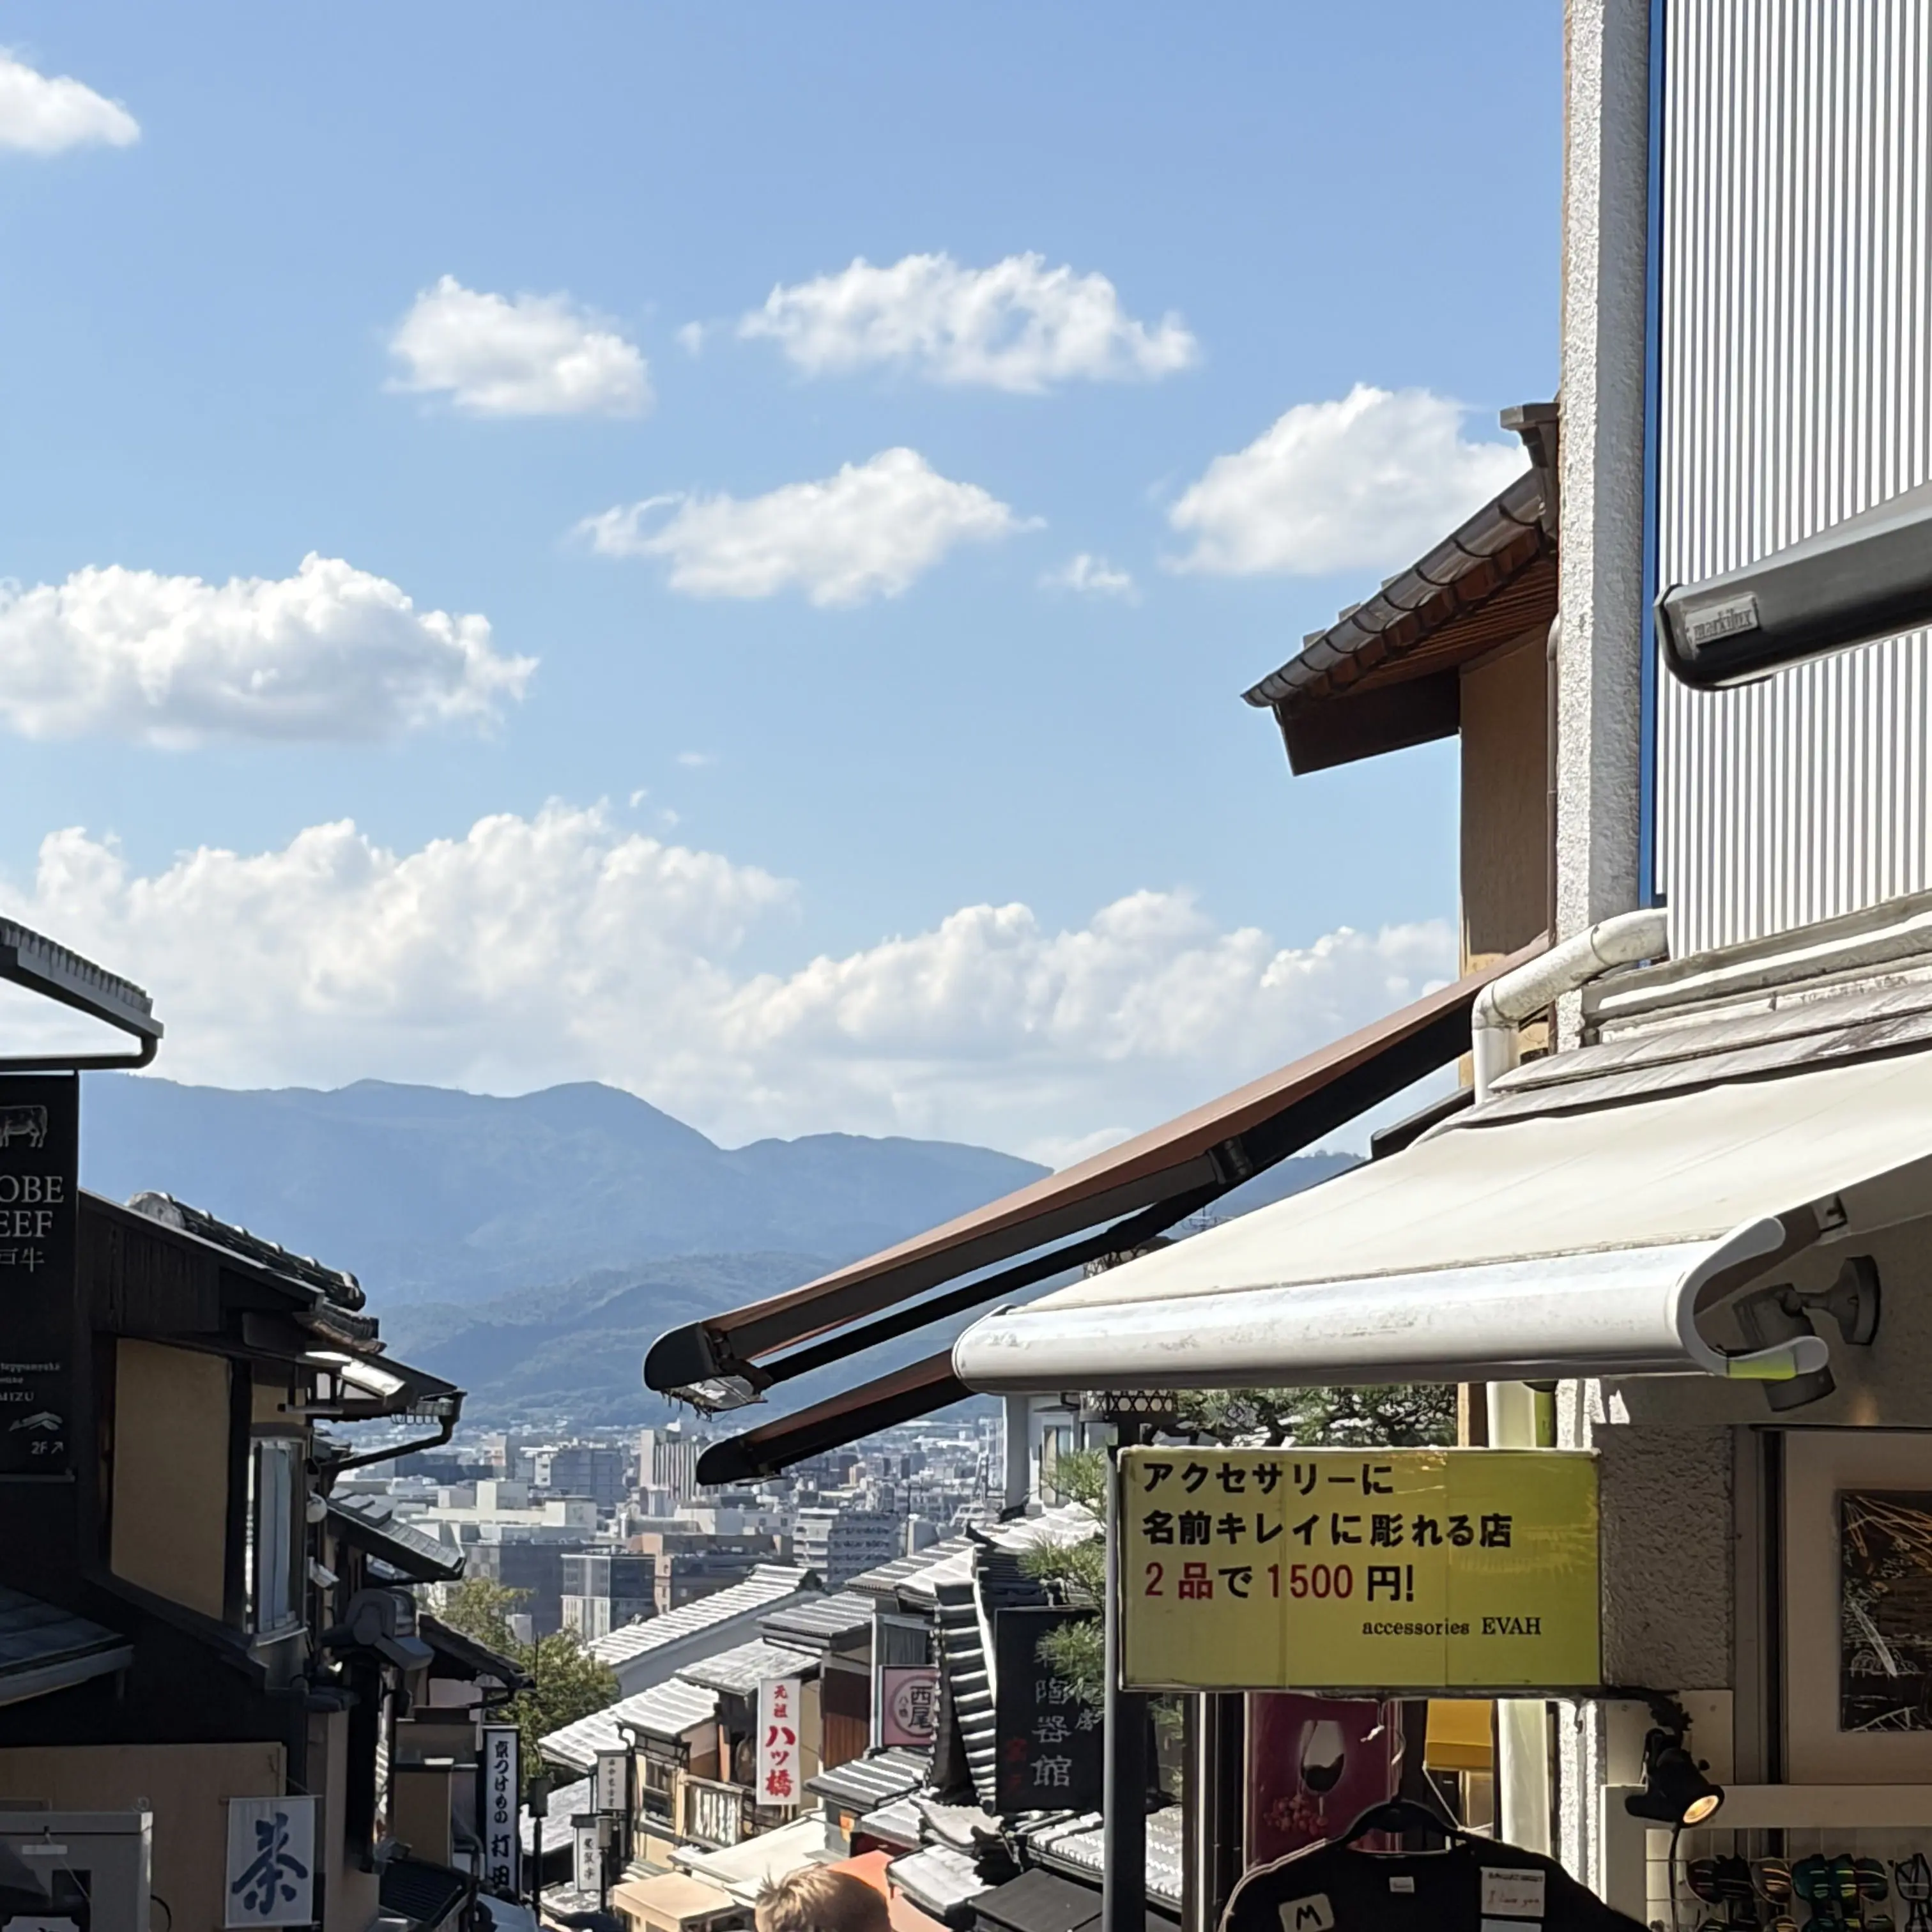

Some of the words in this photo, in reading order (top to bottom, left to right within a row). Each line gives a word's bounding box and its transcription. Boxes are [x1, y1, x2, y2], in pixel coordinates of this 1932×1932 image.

[31, 1441, 48, 1455] 2F
[1143, 1461, 1394, 1496] アクセサリーに
[1142, 1509, 1514, 1548] 名前キレイに彫れる店
[1361, 1617, 1471, 1636] accessories
[1481, 1616, 1542, 1636] EVAH
[908, 1685, 934, 1729] 西尾
[231, 1812, 308, 1916] 茶
[1296, 1904, 1322, 1931] M
